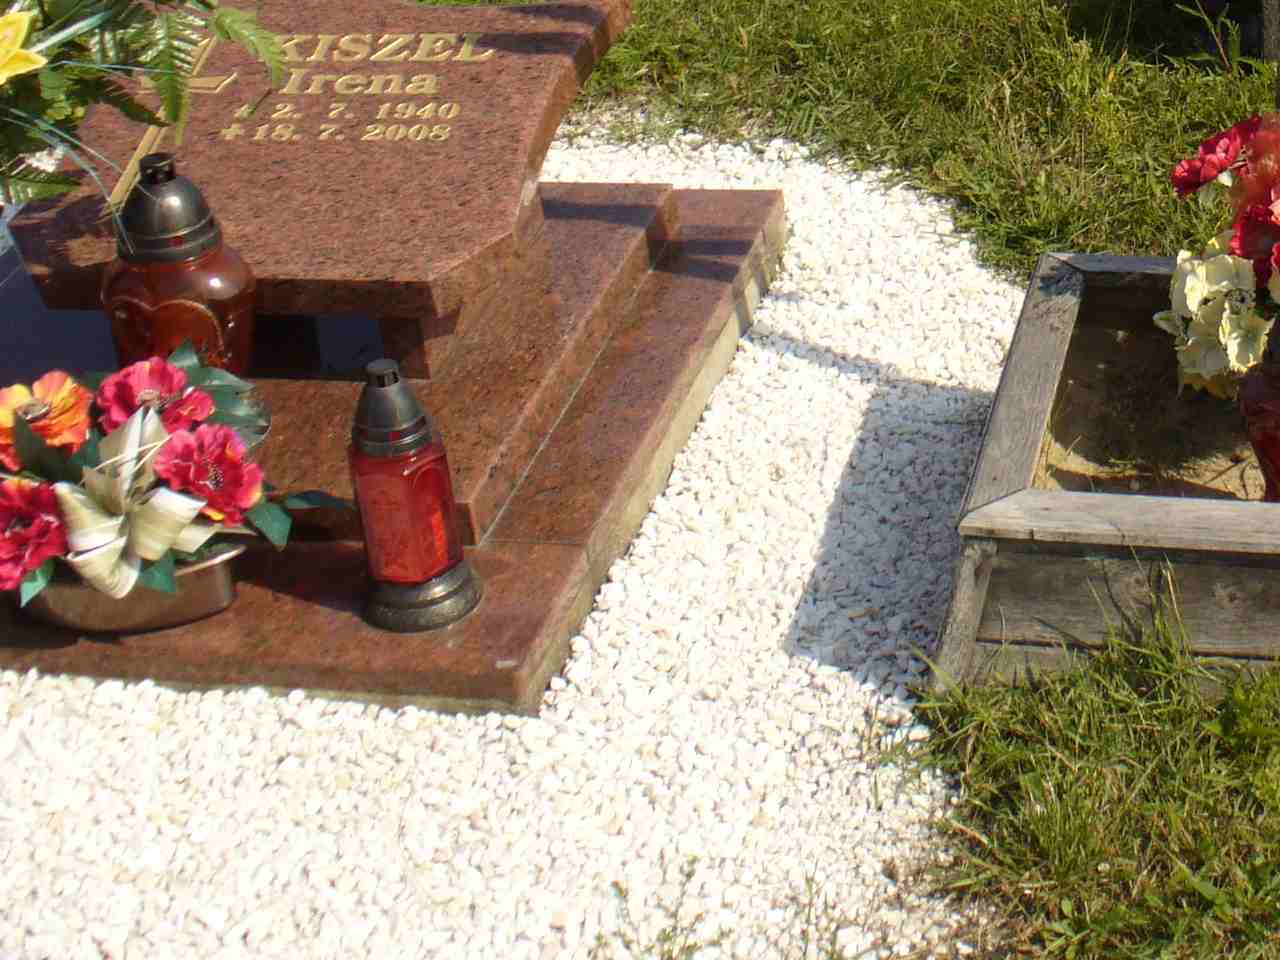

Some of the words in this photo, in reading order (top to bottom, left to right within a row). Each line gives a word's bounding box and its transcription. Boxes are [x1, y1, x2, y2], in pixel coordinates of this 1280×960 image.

[278, 68, 441, 95] Irena
[375, 102, 461, 120] 1940
[360, 122, 452, 142] 2008
